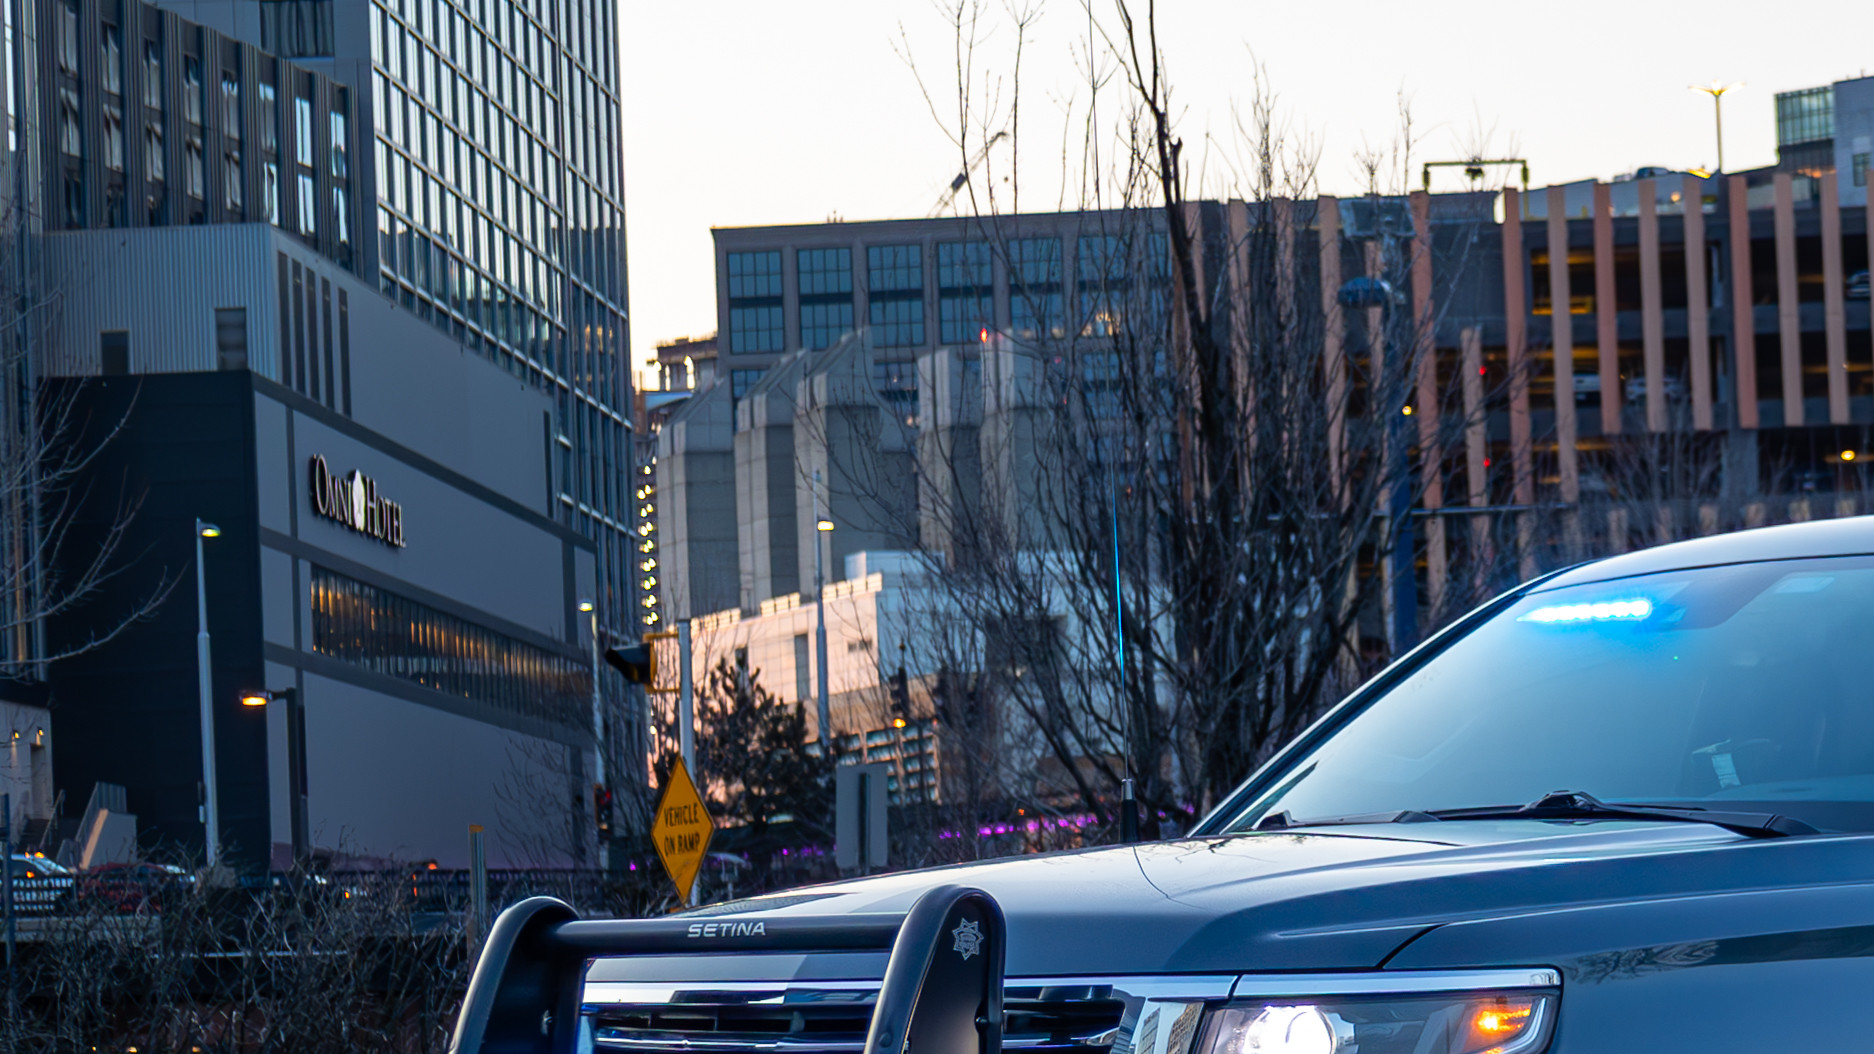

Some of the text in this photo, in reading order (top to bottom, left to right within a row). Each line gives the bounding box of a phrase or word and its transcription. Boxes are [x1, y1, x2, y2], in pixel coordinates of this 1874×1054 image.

[664, 803, 699, 828] VEHICLE
[664, 832, 700, 857] ON RAMP
[687, 922, 766, 938] SETINA
